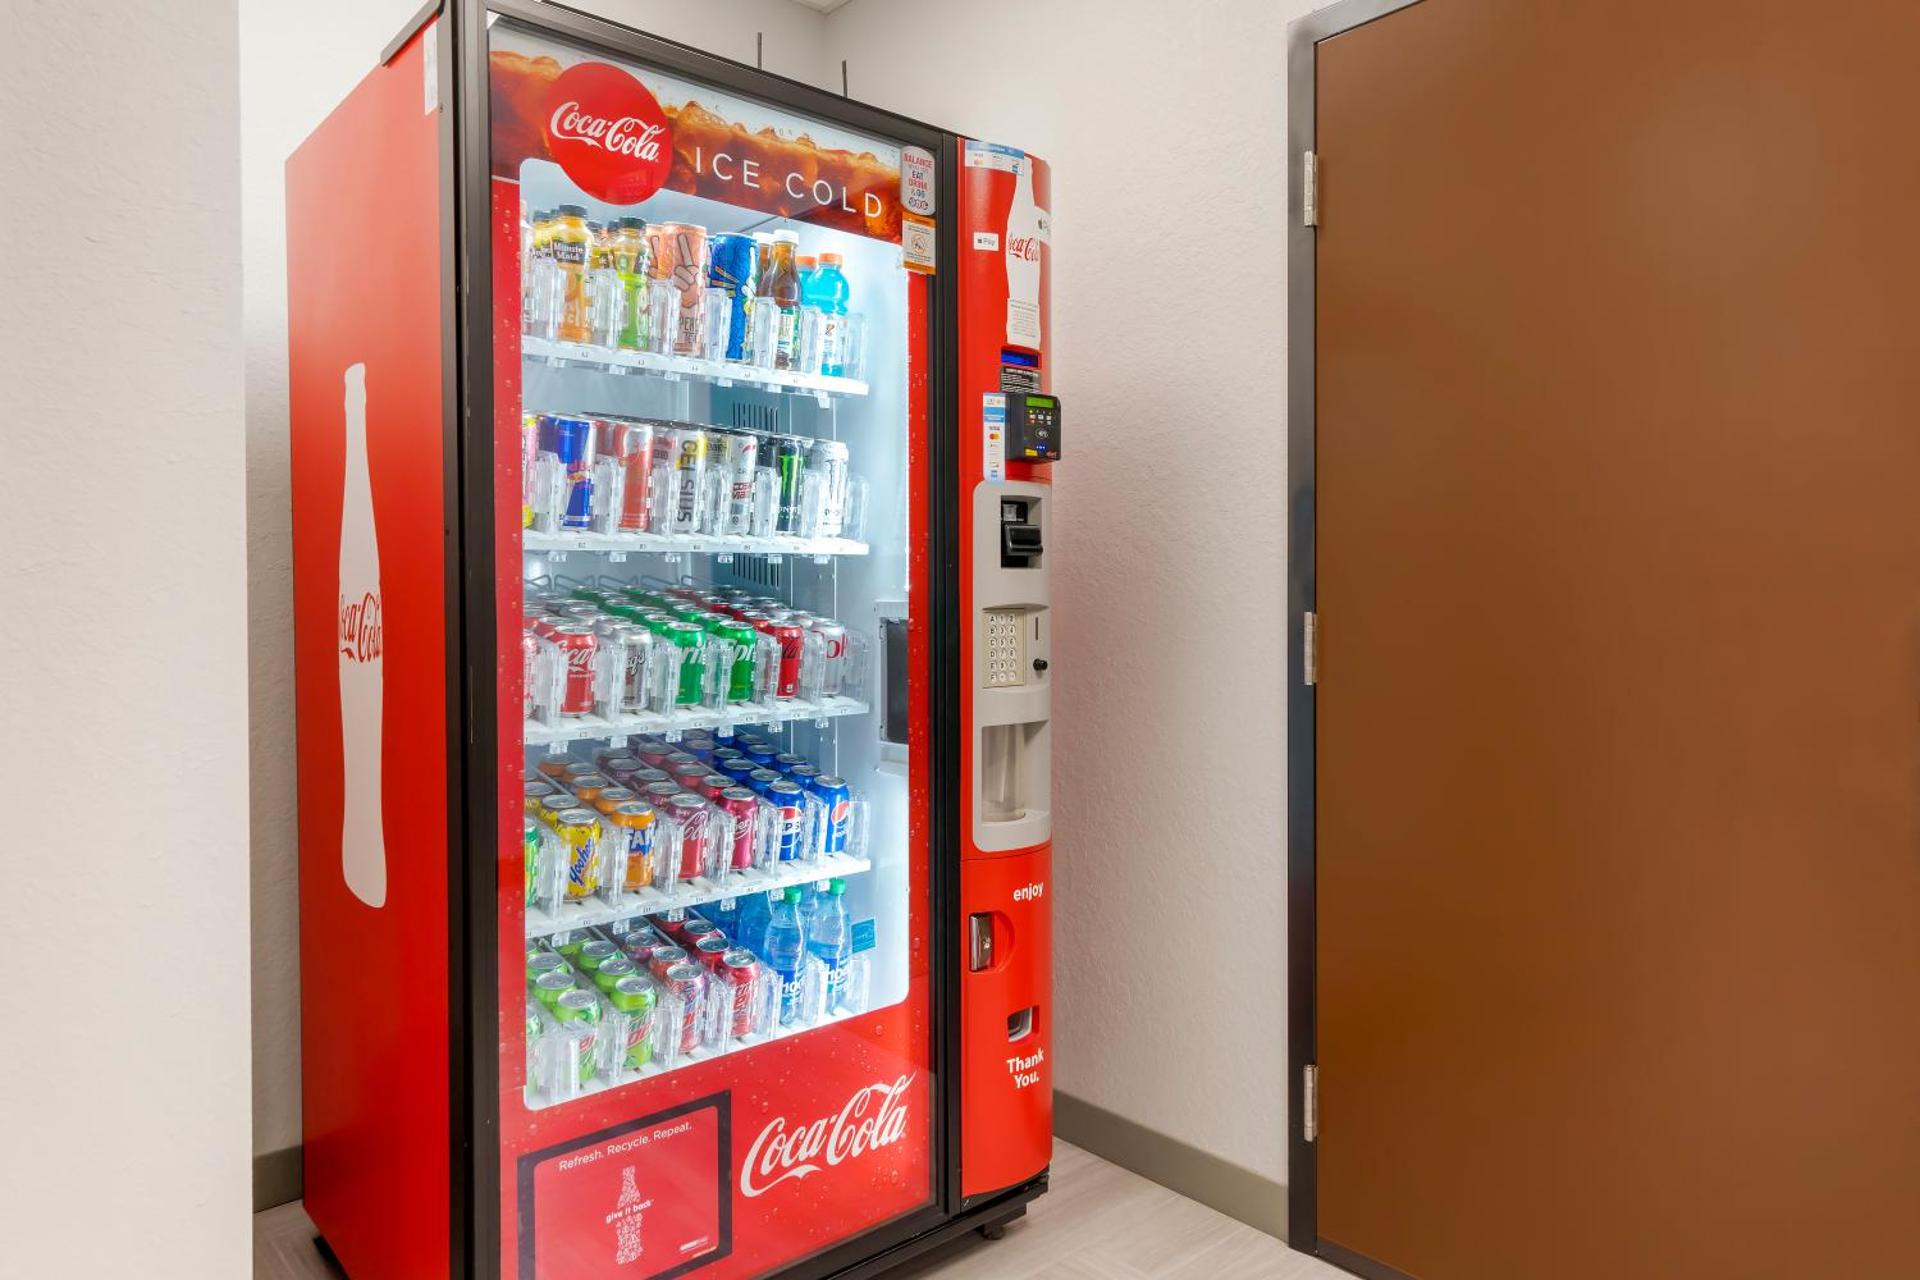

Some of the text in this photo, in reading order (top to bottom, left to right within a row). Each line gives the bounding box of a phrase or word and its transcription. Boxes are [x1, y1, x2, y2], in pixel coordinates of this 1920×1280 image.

[550, 102, 665, 161] Coca-Cola
[696, 148, 882, 217] ICE COLD
[1013, 882, 1043, 901] enjoy
[1007, 1048, 1044, 1073] Thank
[1014, 1072, 1039, 1088] You.
[559, 1122, 692, 1171] Refresh. Recycle. Repeat.
[740, 1071, 918, 1197] Coca-Cola
